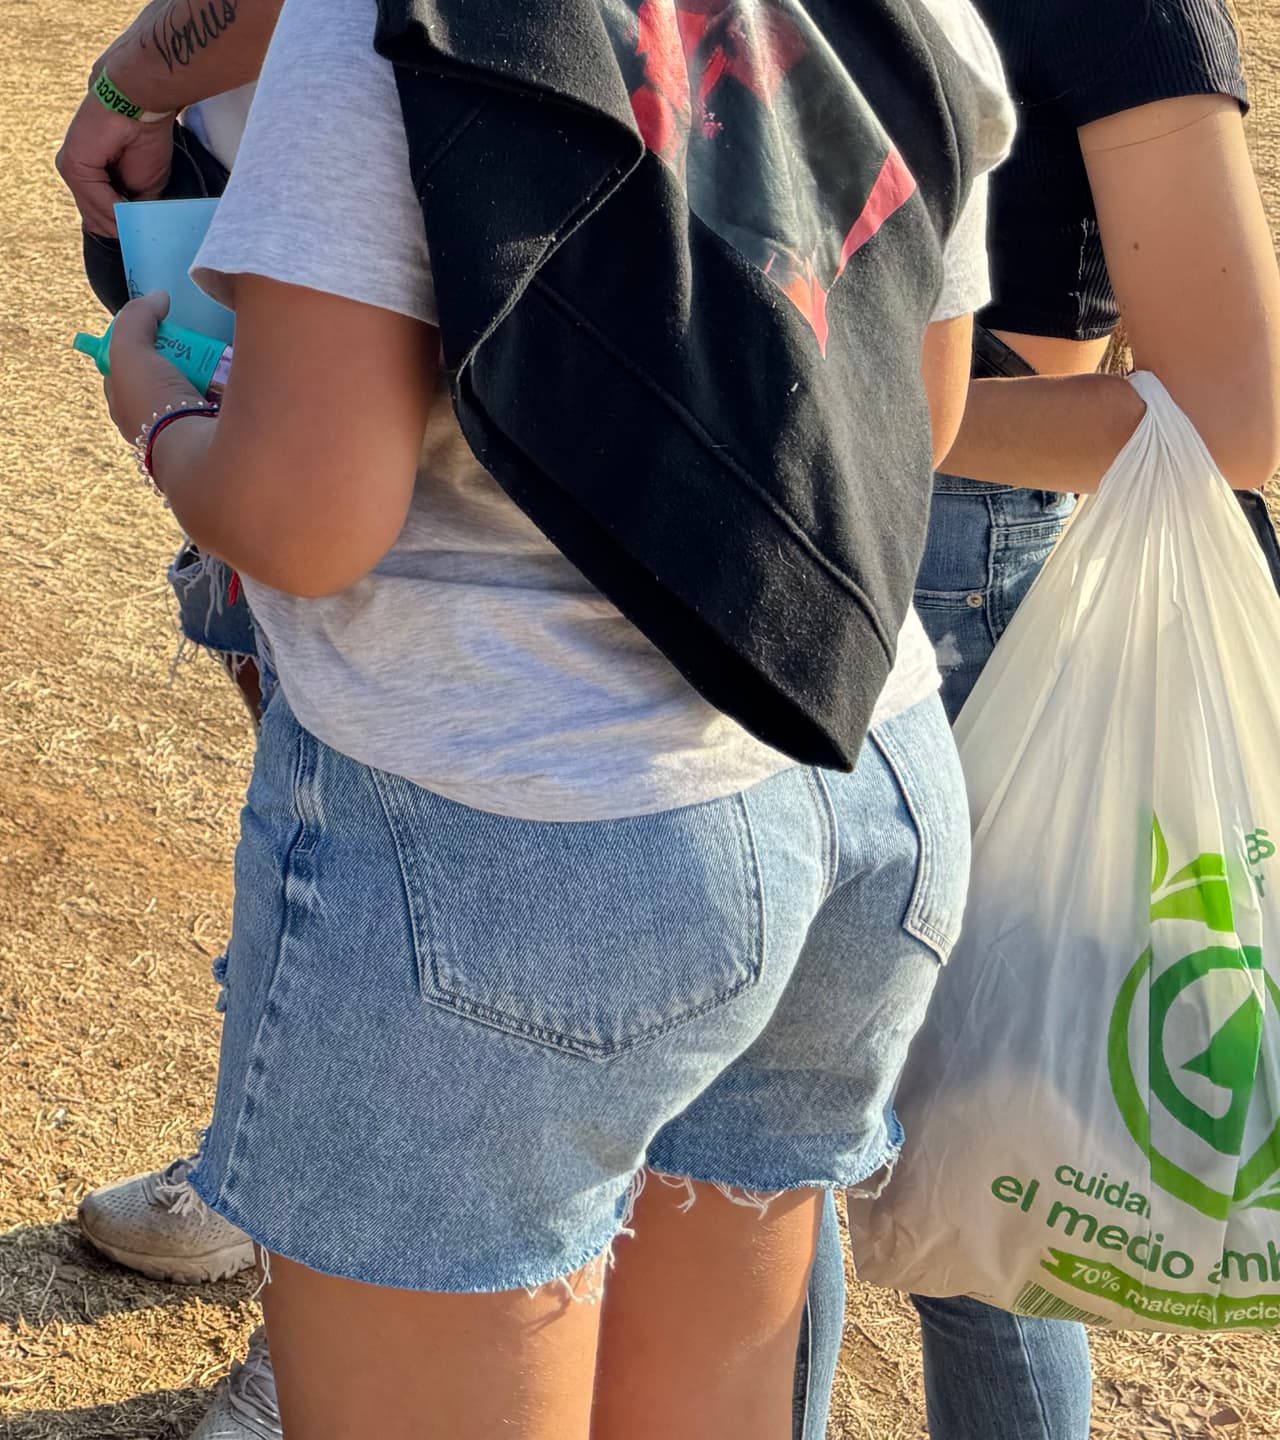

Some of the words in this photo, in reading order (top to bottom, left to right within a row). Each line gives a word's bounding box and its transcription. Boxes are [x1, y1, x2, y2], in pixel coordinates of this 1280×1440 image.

[991, 1175, 1040, 1212] el
[1046, 1200, 1195, 1279] medio
[1071, 1262, 1121, 1292] 70%
[1125, 1288, 1218, 1324] material
[1223, 1301, 1280, 1323] recic
